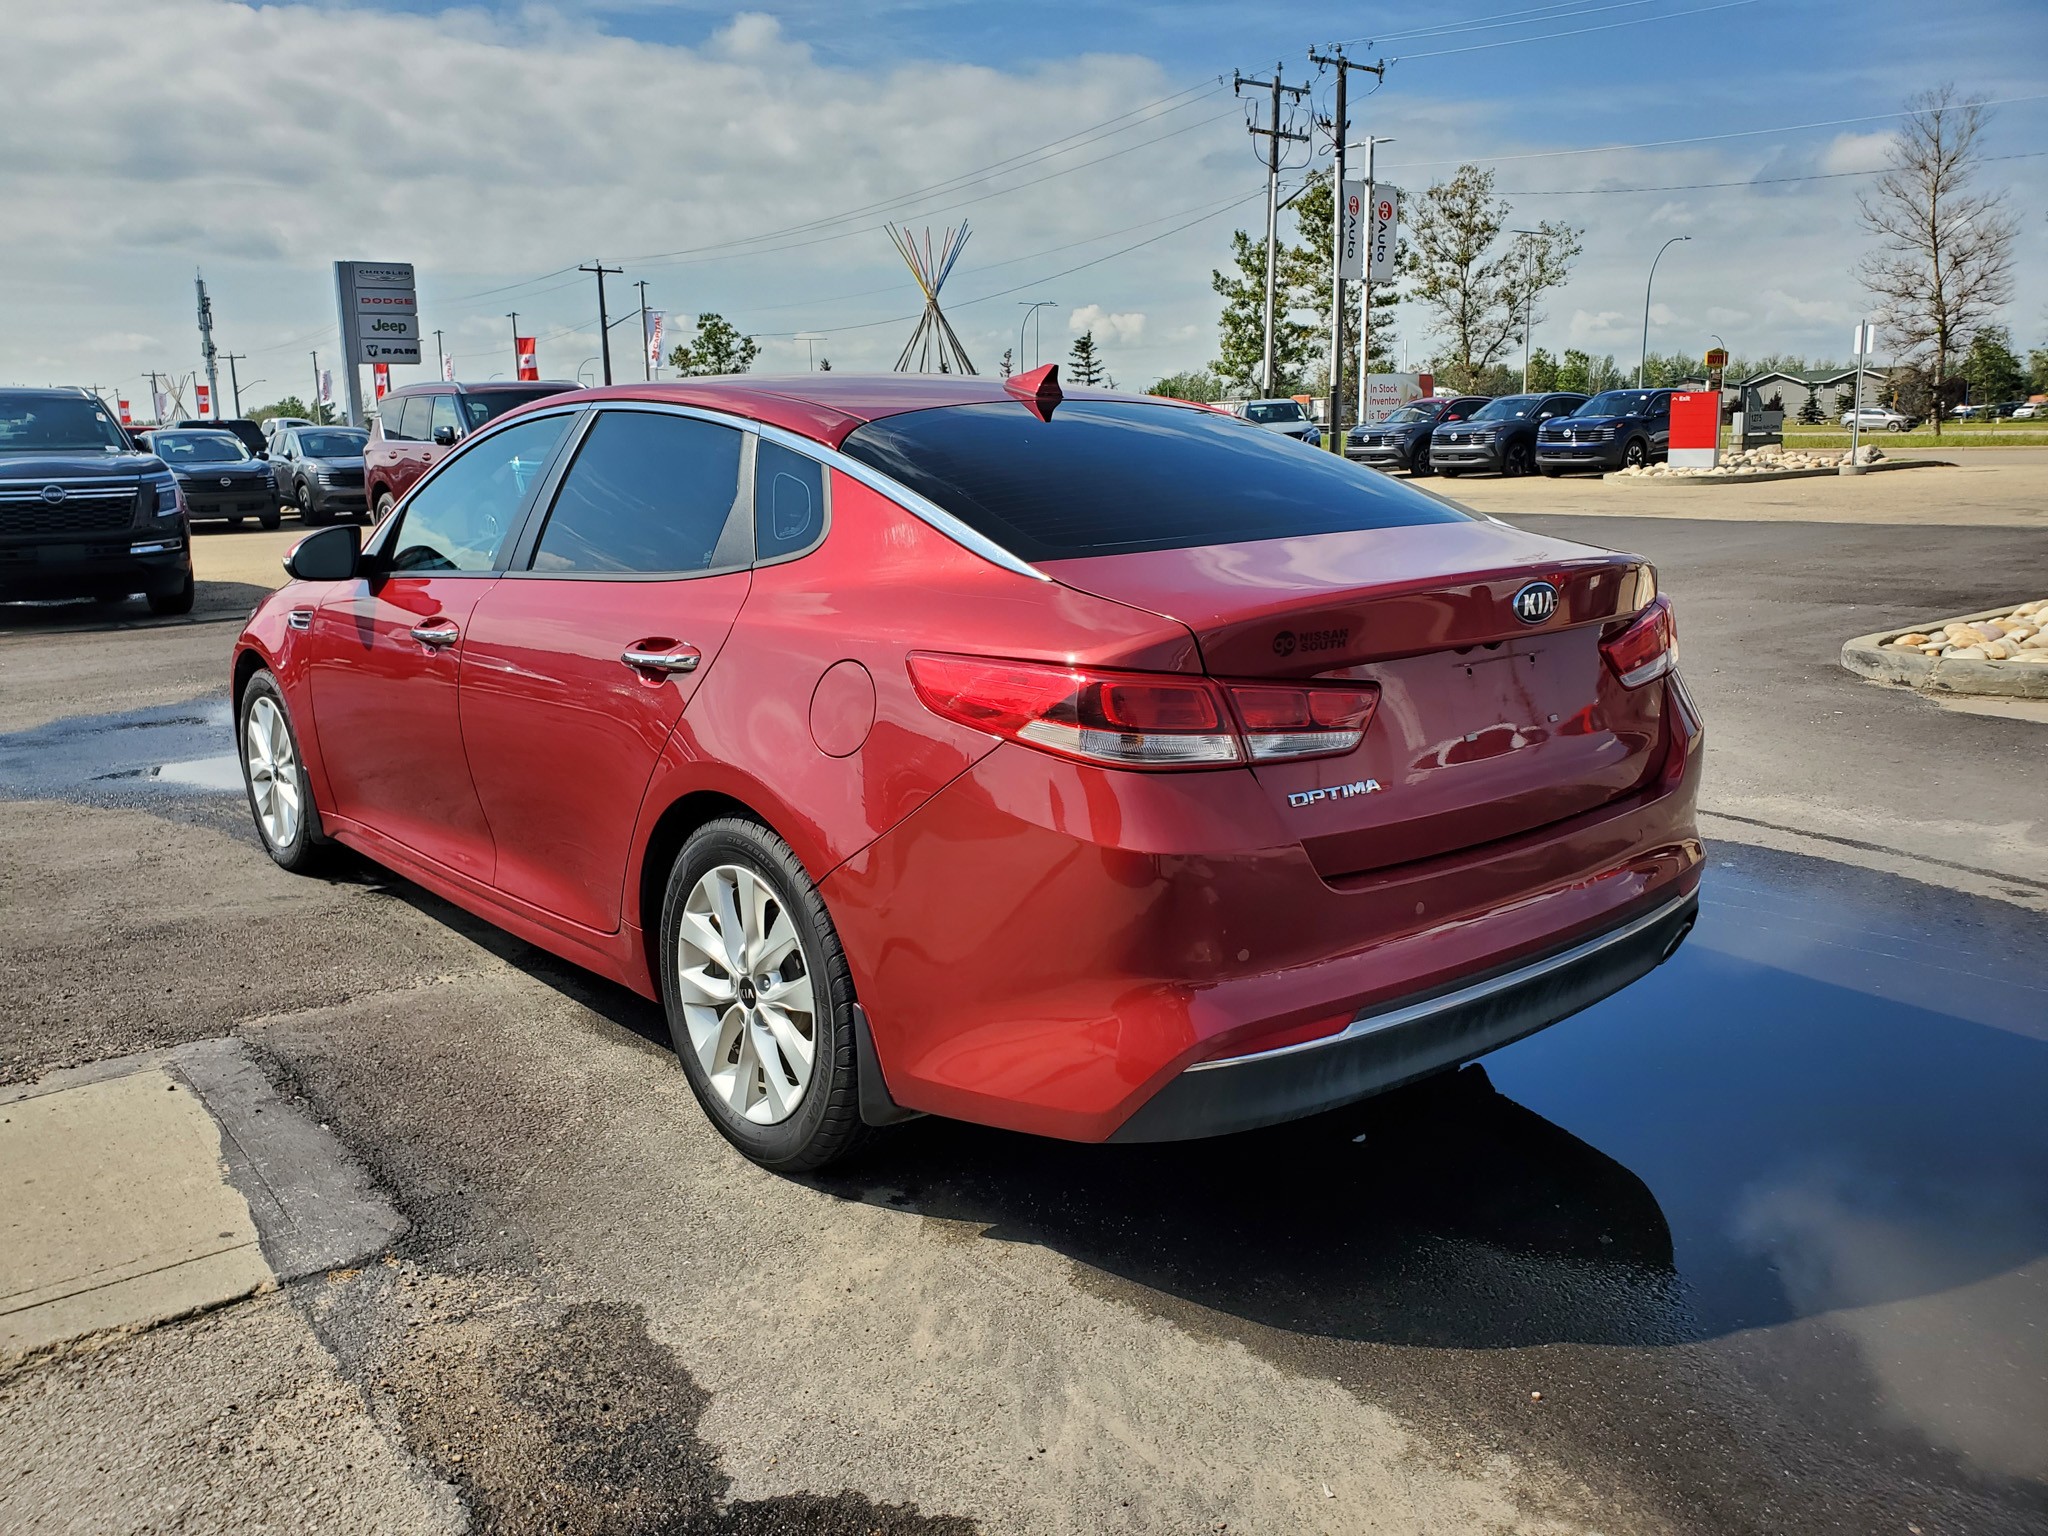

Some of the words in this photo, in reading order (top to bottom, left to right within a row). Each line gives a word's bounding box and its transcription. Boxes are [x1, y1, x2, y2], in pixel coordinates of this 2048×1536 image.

[1347, 215, 1357, 259] Auto
[1377, 220, 1388, 263] Auto
[361, 297, 414, 305] DODGE
[371, 318, 408, 334] Jeep
[381, 347, 418, 355] RAM
[1370, 383, 1377, 393] In
[1379, 383, 1398, 393] Stock
[1369, 397, 1402, 406] Inventory
[1368, 410, 1375, 420] is
[1523, 591, 1554, 616] KIA
[1300, 628, 1349, 642] NISSAN
[1300, 639, 1346, 652] SOUTH
[1286, 779, 1382, 808] OPTIMA
